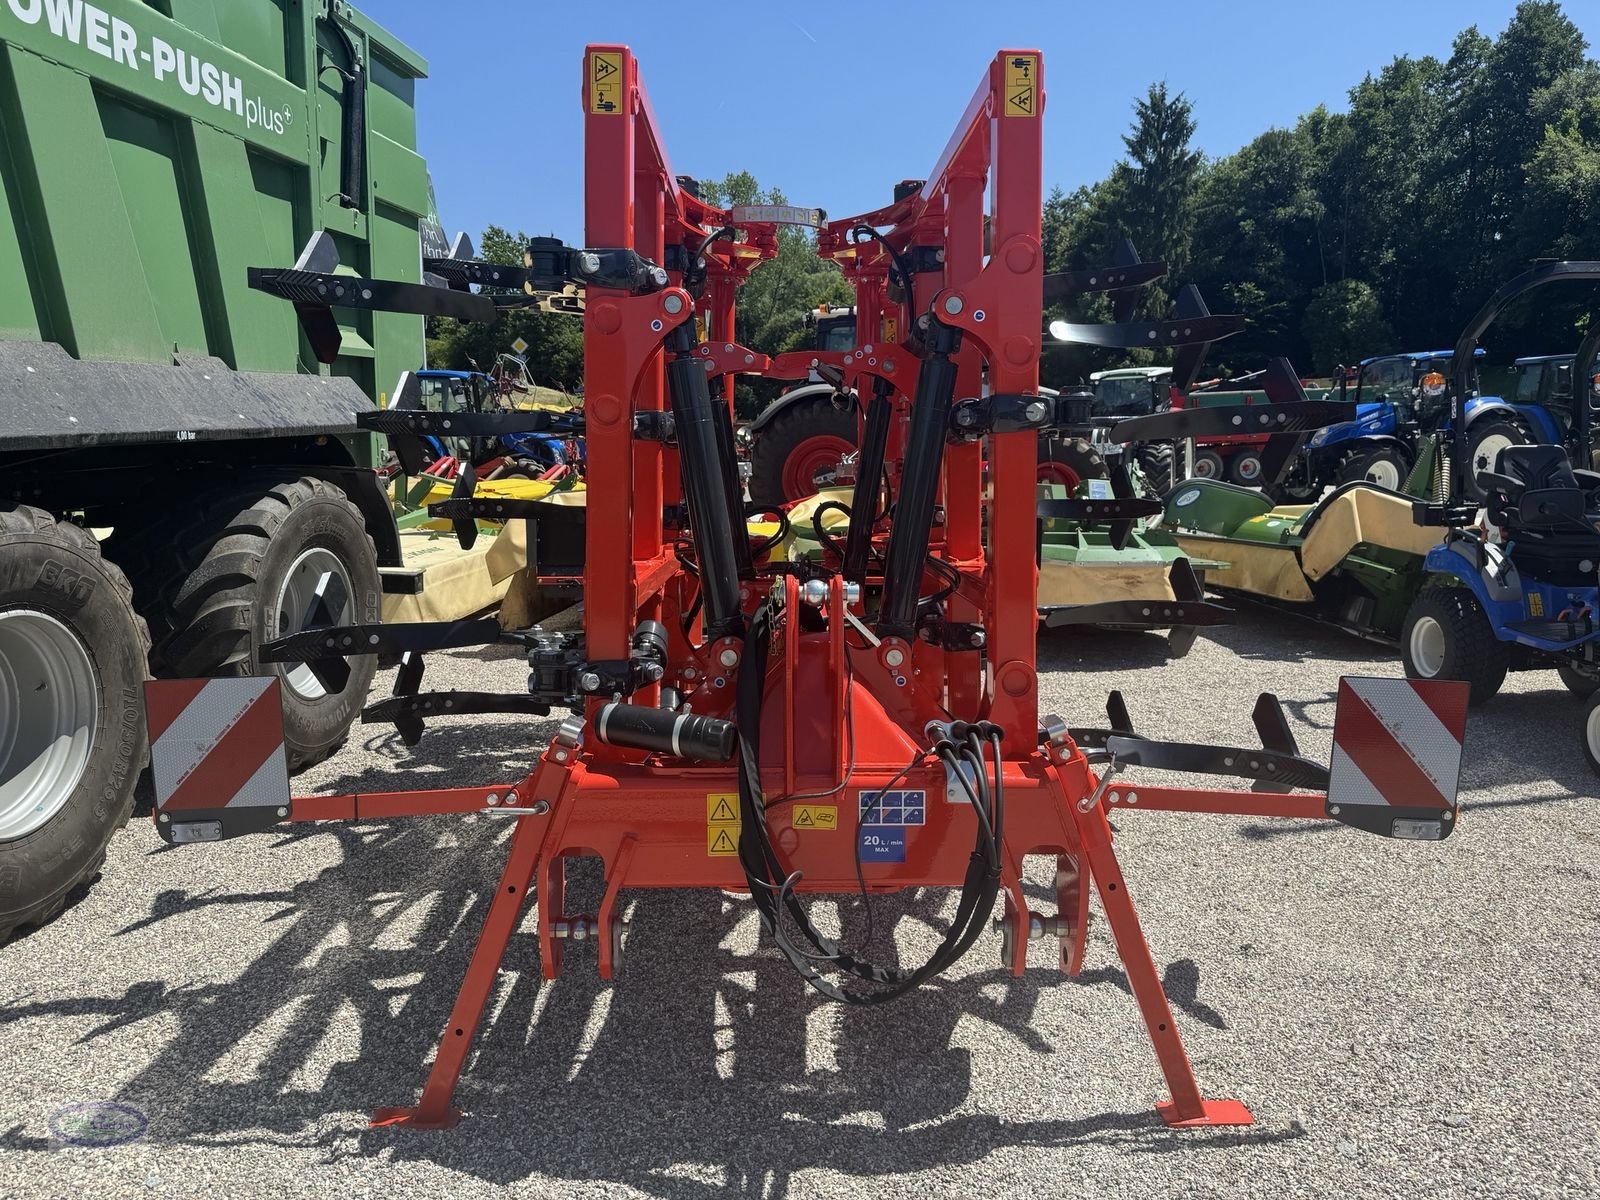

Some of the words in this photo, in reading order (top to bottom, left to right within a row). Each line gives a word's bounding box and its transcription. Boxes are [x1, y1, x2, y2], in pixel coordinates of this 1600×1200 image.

[5, 0, 243, 116] OWER-PUSH
[37, 561, 95, 602] BKT
[864, 836, 880, 846] 20
